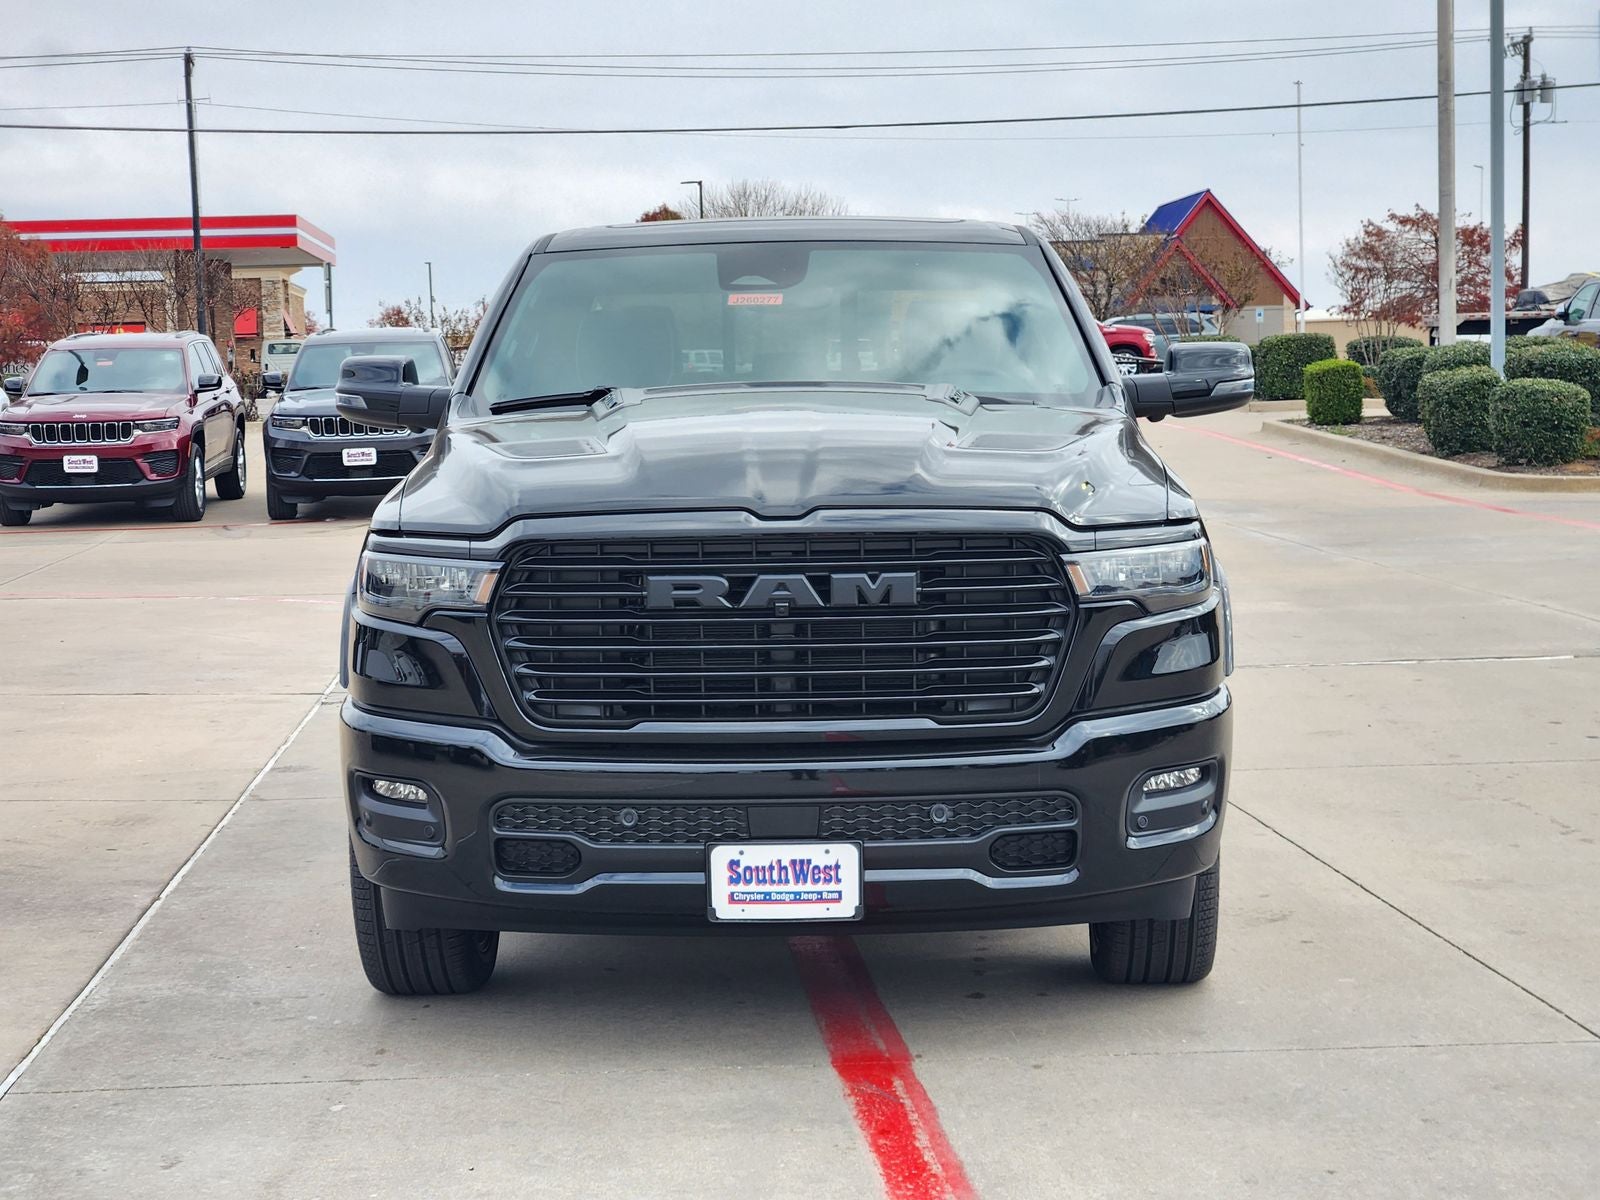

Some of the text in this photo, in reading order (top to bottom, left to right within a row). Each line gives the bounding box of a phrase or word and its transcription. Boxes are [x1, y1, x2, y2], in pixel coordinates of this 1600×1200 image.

[732, 296, 779, 304] J260277
[645, 572, 921, 608] RAM
[727, 858, 842, 886] SouthWest
[733, 891, 839, 902] Chrysler Dodge Jeep Ram
